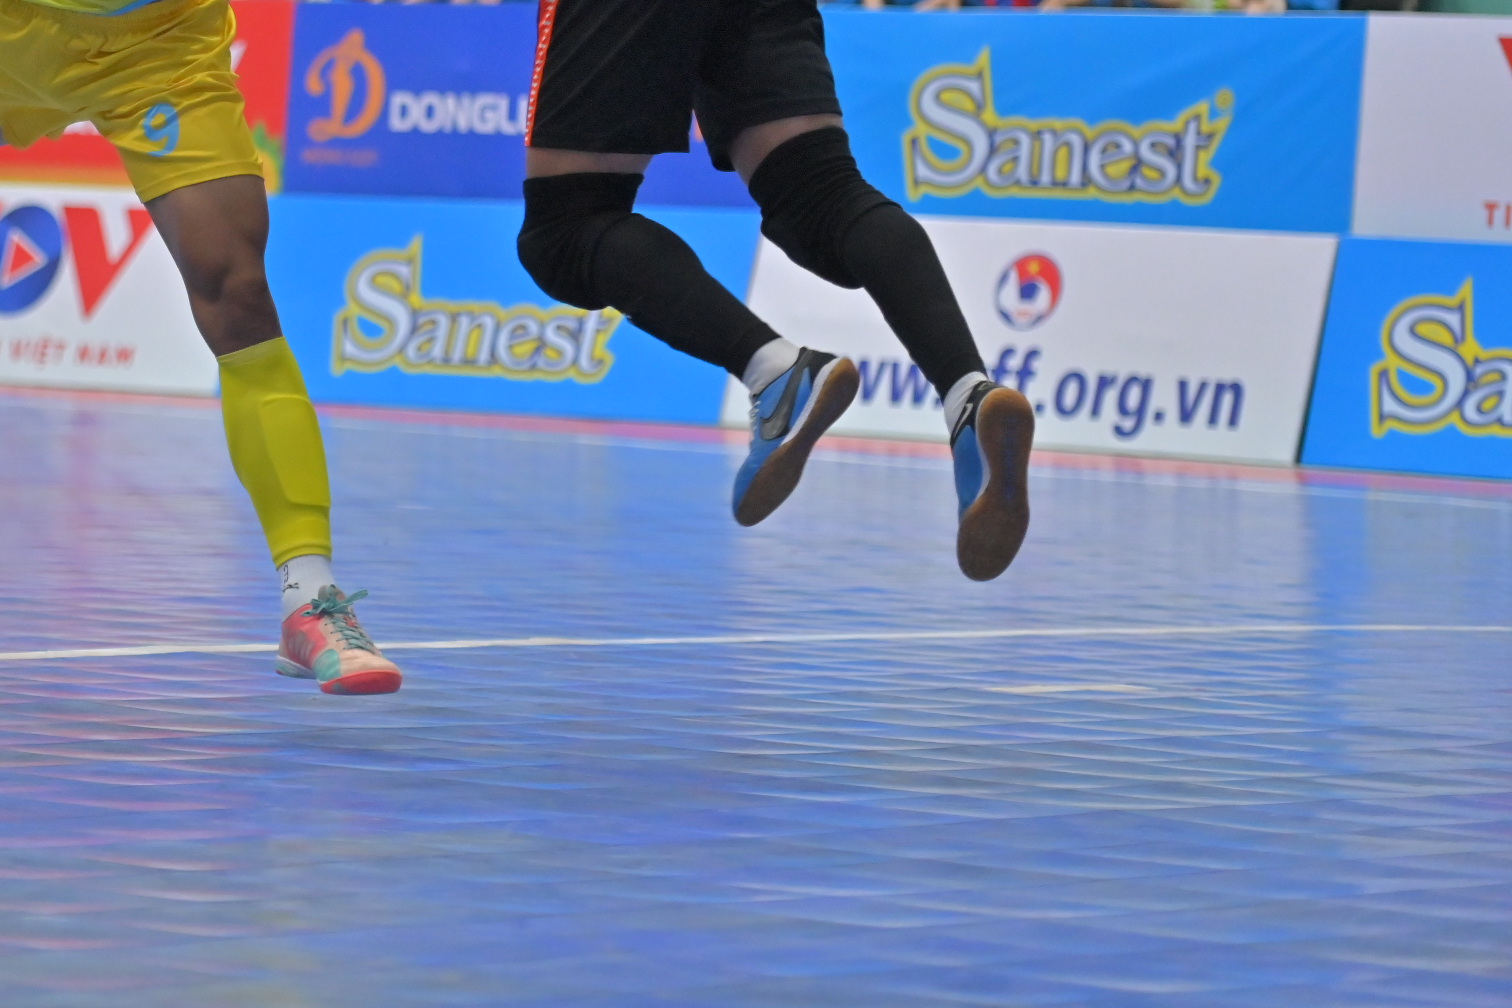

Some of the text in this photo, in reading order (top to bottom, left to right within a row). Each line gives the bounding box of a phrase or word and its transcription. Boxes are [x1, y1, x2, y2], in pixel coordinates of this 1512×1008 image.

[143, 102, 180, 157] 9
[903, 52, 1228, 203] Sanest
[333, 240, 621, 382] Sanest
